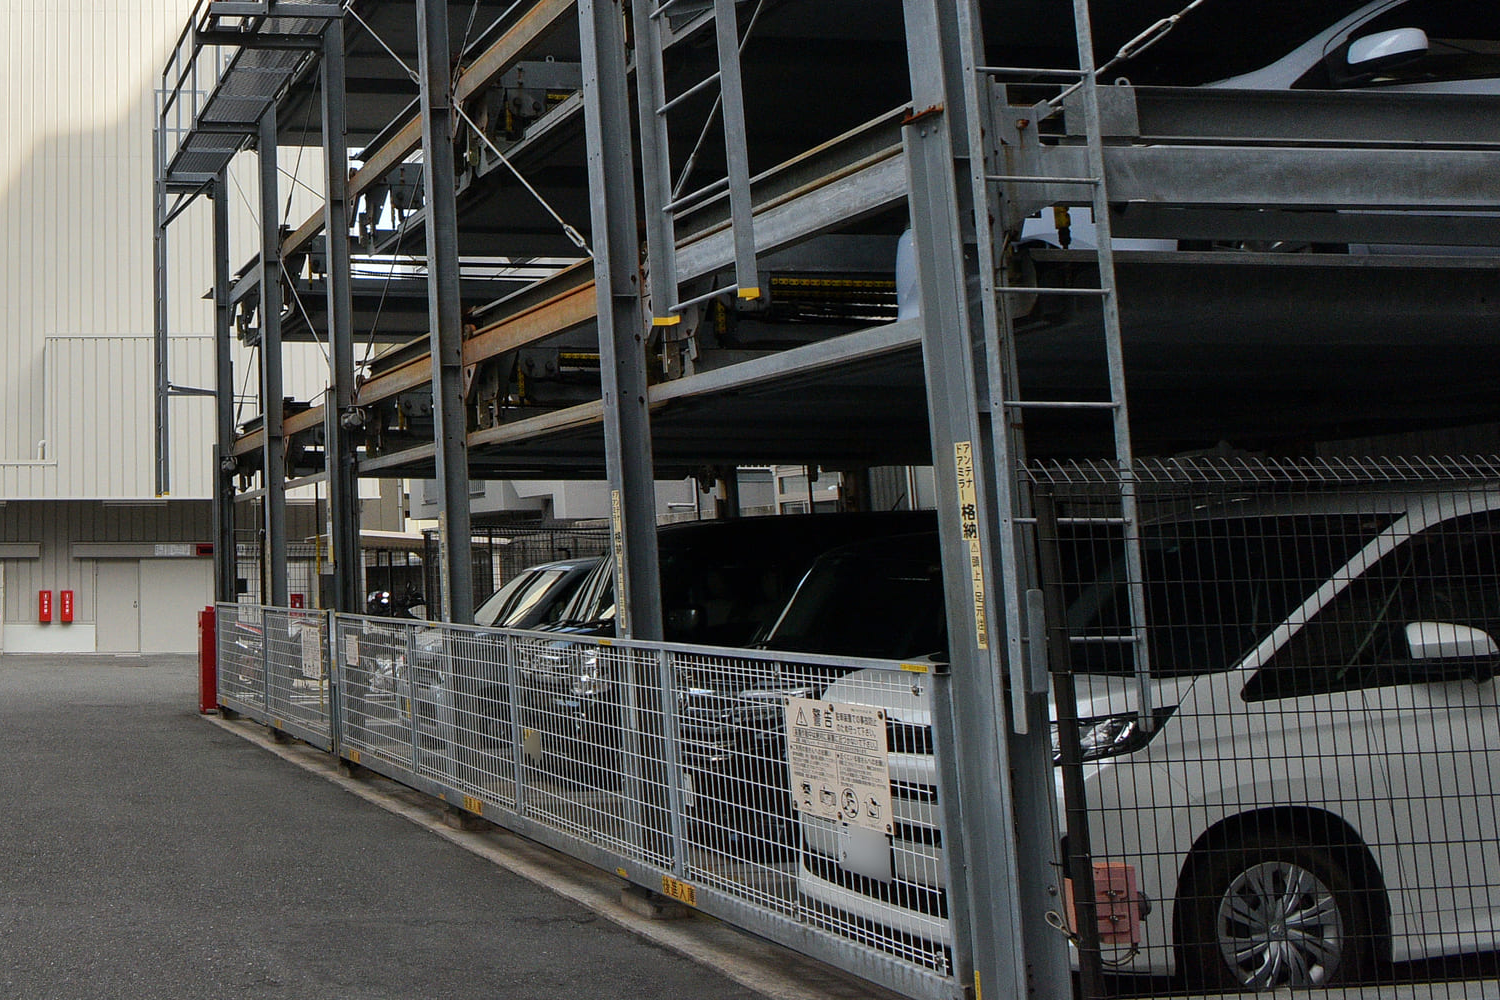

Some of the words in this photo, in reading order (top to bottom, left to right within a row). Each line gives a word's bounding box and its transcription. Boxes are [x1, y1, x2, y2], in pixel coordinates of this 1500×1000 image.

[956, 443, 966, 501] ドアミラー
[962, 443, 973, 489] アンテナ
[961, 503, 977, 539] 格納
[812, 707, 833, 729] 警告
